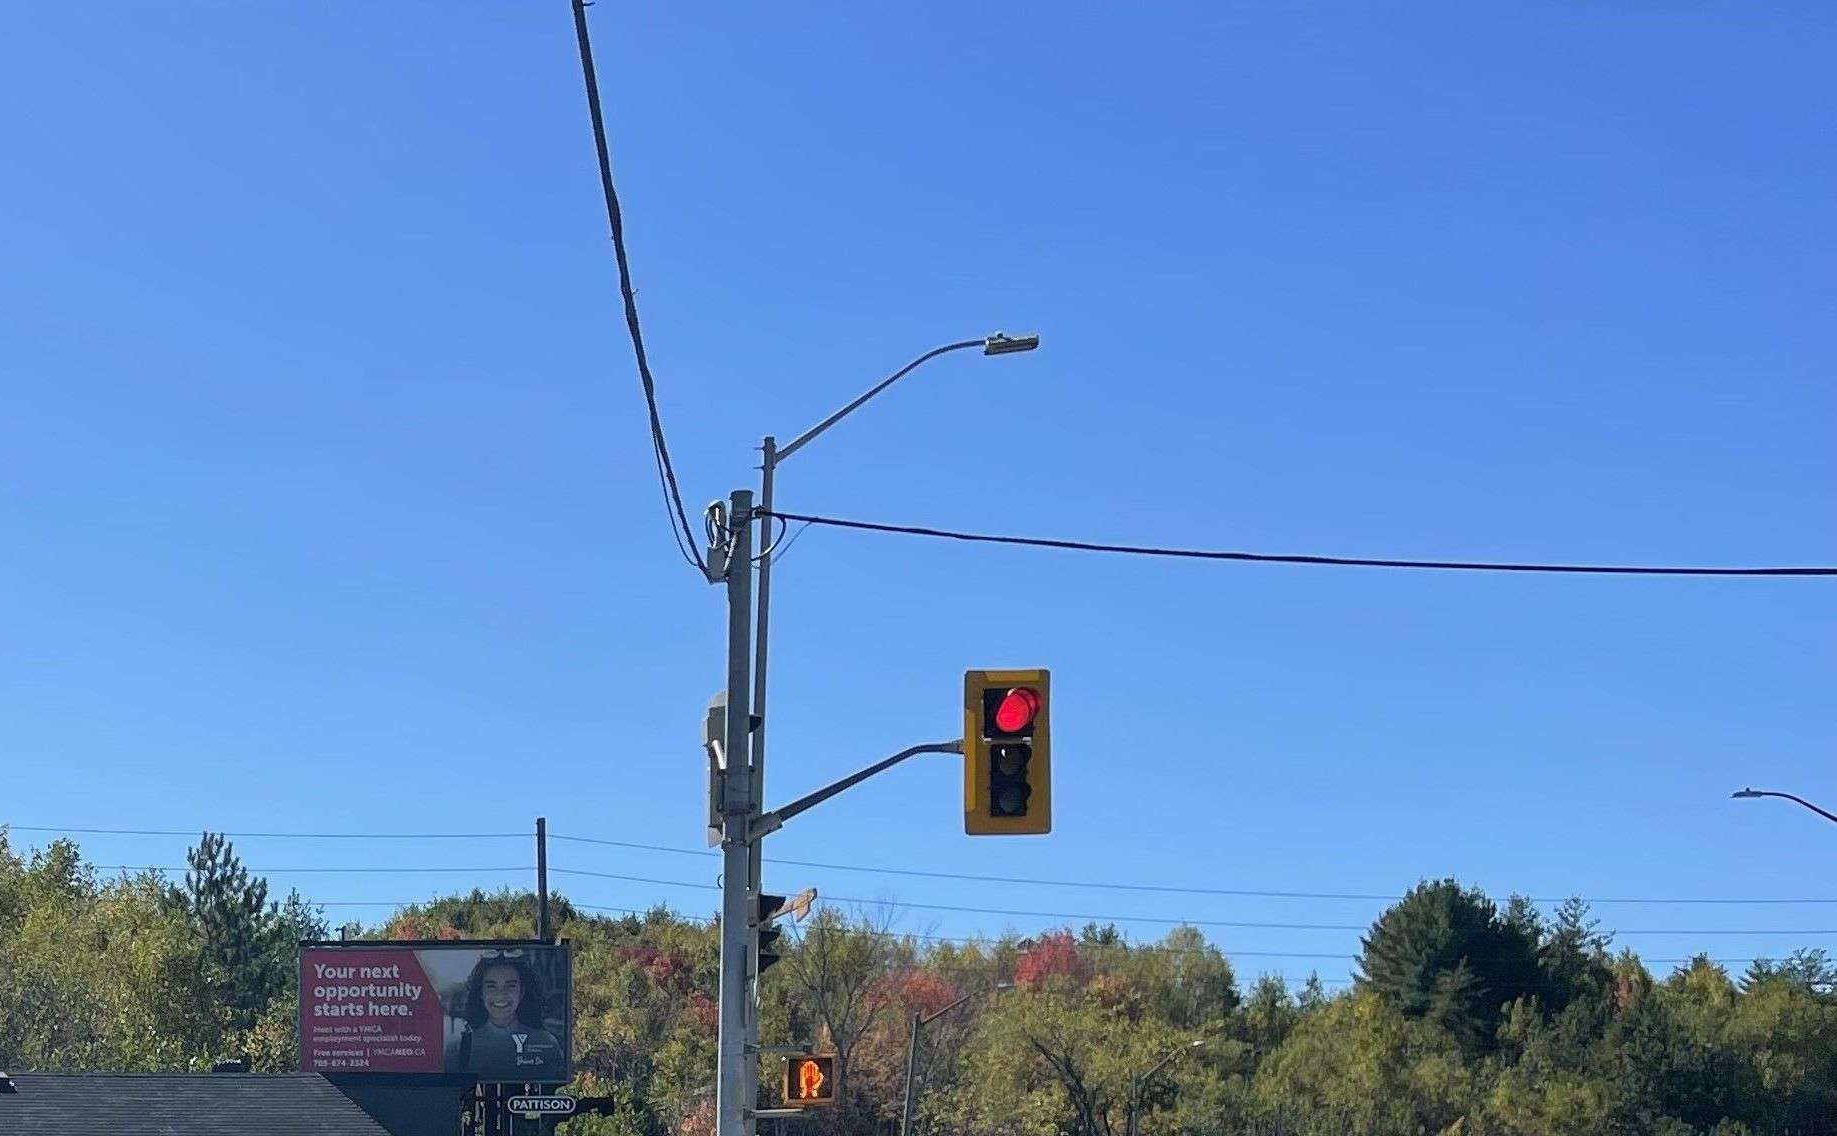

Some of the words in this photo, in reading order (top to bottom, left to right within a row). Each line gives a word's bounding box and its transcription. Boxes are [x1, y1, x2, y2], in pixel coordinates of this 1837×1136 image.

[314, 963, 356, 979] Your
[360, 964, 399, 979] next
[313, 981, 422, 1001] opportunity
[314, 1002, 364, 1017] starts
[368, 1001, 413, 1017] here.
[359, 1025, 383, 1034] YMCA
[513, 1100, 570, 1110] PATTISON
